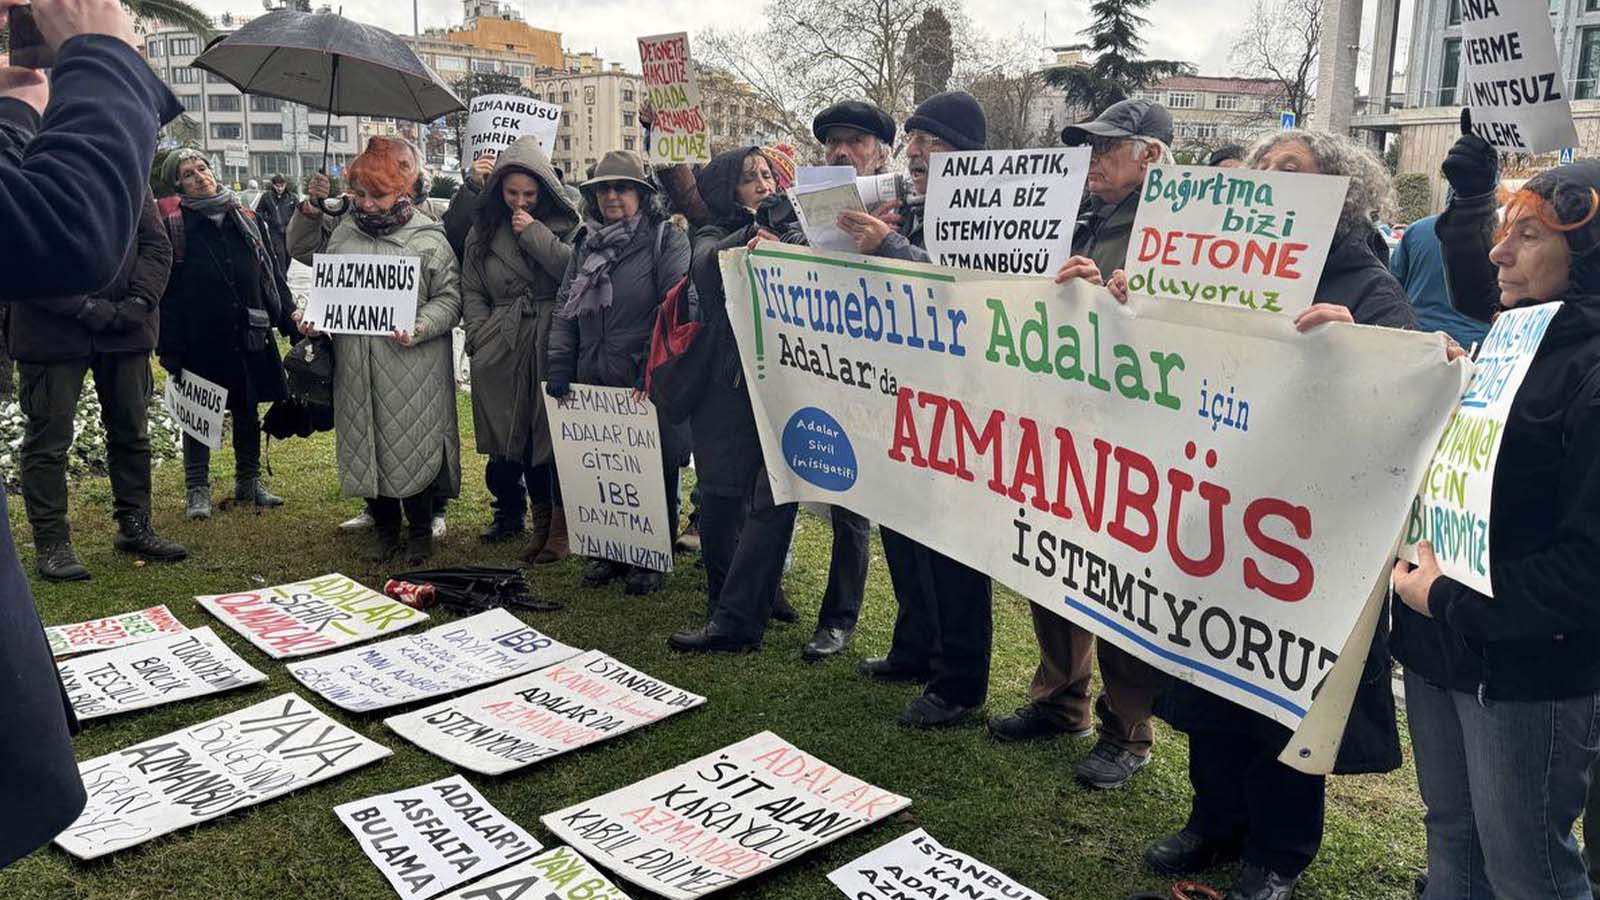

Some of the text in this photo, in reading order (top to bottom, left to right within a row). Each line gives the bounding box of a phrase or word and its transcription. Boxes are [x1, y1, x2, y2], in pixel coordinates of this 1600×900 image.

[1464, 32, 1522, 66] VERME
[1473, 72, 1561, 107] MUTSUZ
[471, 100, 558, 121] AZMANBÜSÜ
[492, 116, 521, 130] ÇEK
[471, 132, 516, 146] TAHRİB
[658, 134, 708, 161] OLMAZ
[942, 153, 1069, 177] ANLA ARTIK,
[949, 183, 1047, 209] ANLA BİZ
[1143, 168, 1273, 213] Bağırtma
[935, 214, 1060, 241] İSTEMİYORUZ
[1222, 207, 1296, 239] bizi
[1138, 226, 1308, 280] DETONE
[315, 259, 415, 291] HA AZMANBÜS
[1128, 267, 1283, 312] oluyoruz
[323, 304, 396, 331] HA KANAL
[753, 266, 1249, 432] Yürünebilir Adalar için
[561, 422, 657, 449] ADALAR'DAN
[796, 418, 840, 439] Adalar
[582, 447, 641, 474] GİTSİN
[808, 439, 835, 455] Sivil
[596, 476, 641, 508] İBB
[888, 386, 1314, 602] AZMANBÜS
[578, 505, 654, 535] DAYATMA
[1406, 494, 1487, 576] BURADAYIZ
[295, 577, 416, 630] ADALAR
[441, 628, 529, 670] DAYATMA
[515, 687, 625, 733] ADALAR'DA
[240, 699, 363, 778] YAYA
[121, 742, 257, 816] AZMANBÜS
[394, 798, 481, 874] ASFALTA
[432, 783, 532, 860] ADALAR'I
[350, 806, 437, 894] BULAMA
[561, 808, 738, 893] KABUL EDİLMEZ
[530, 847, 586, 890] YAYA
